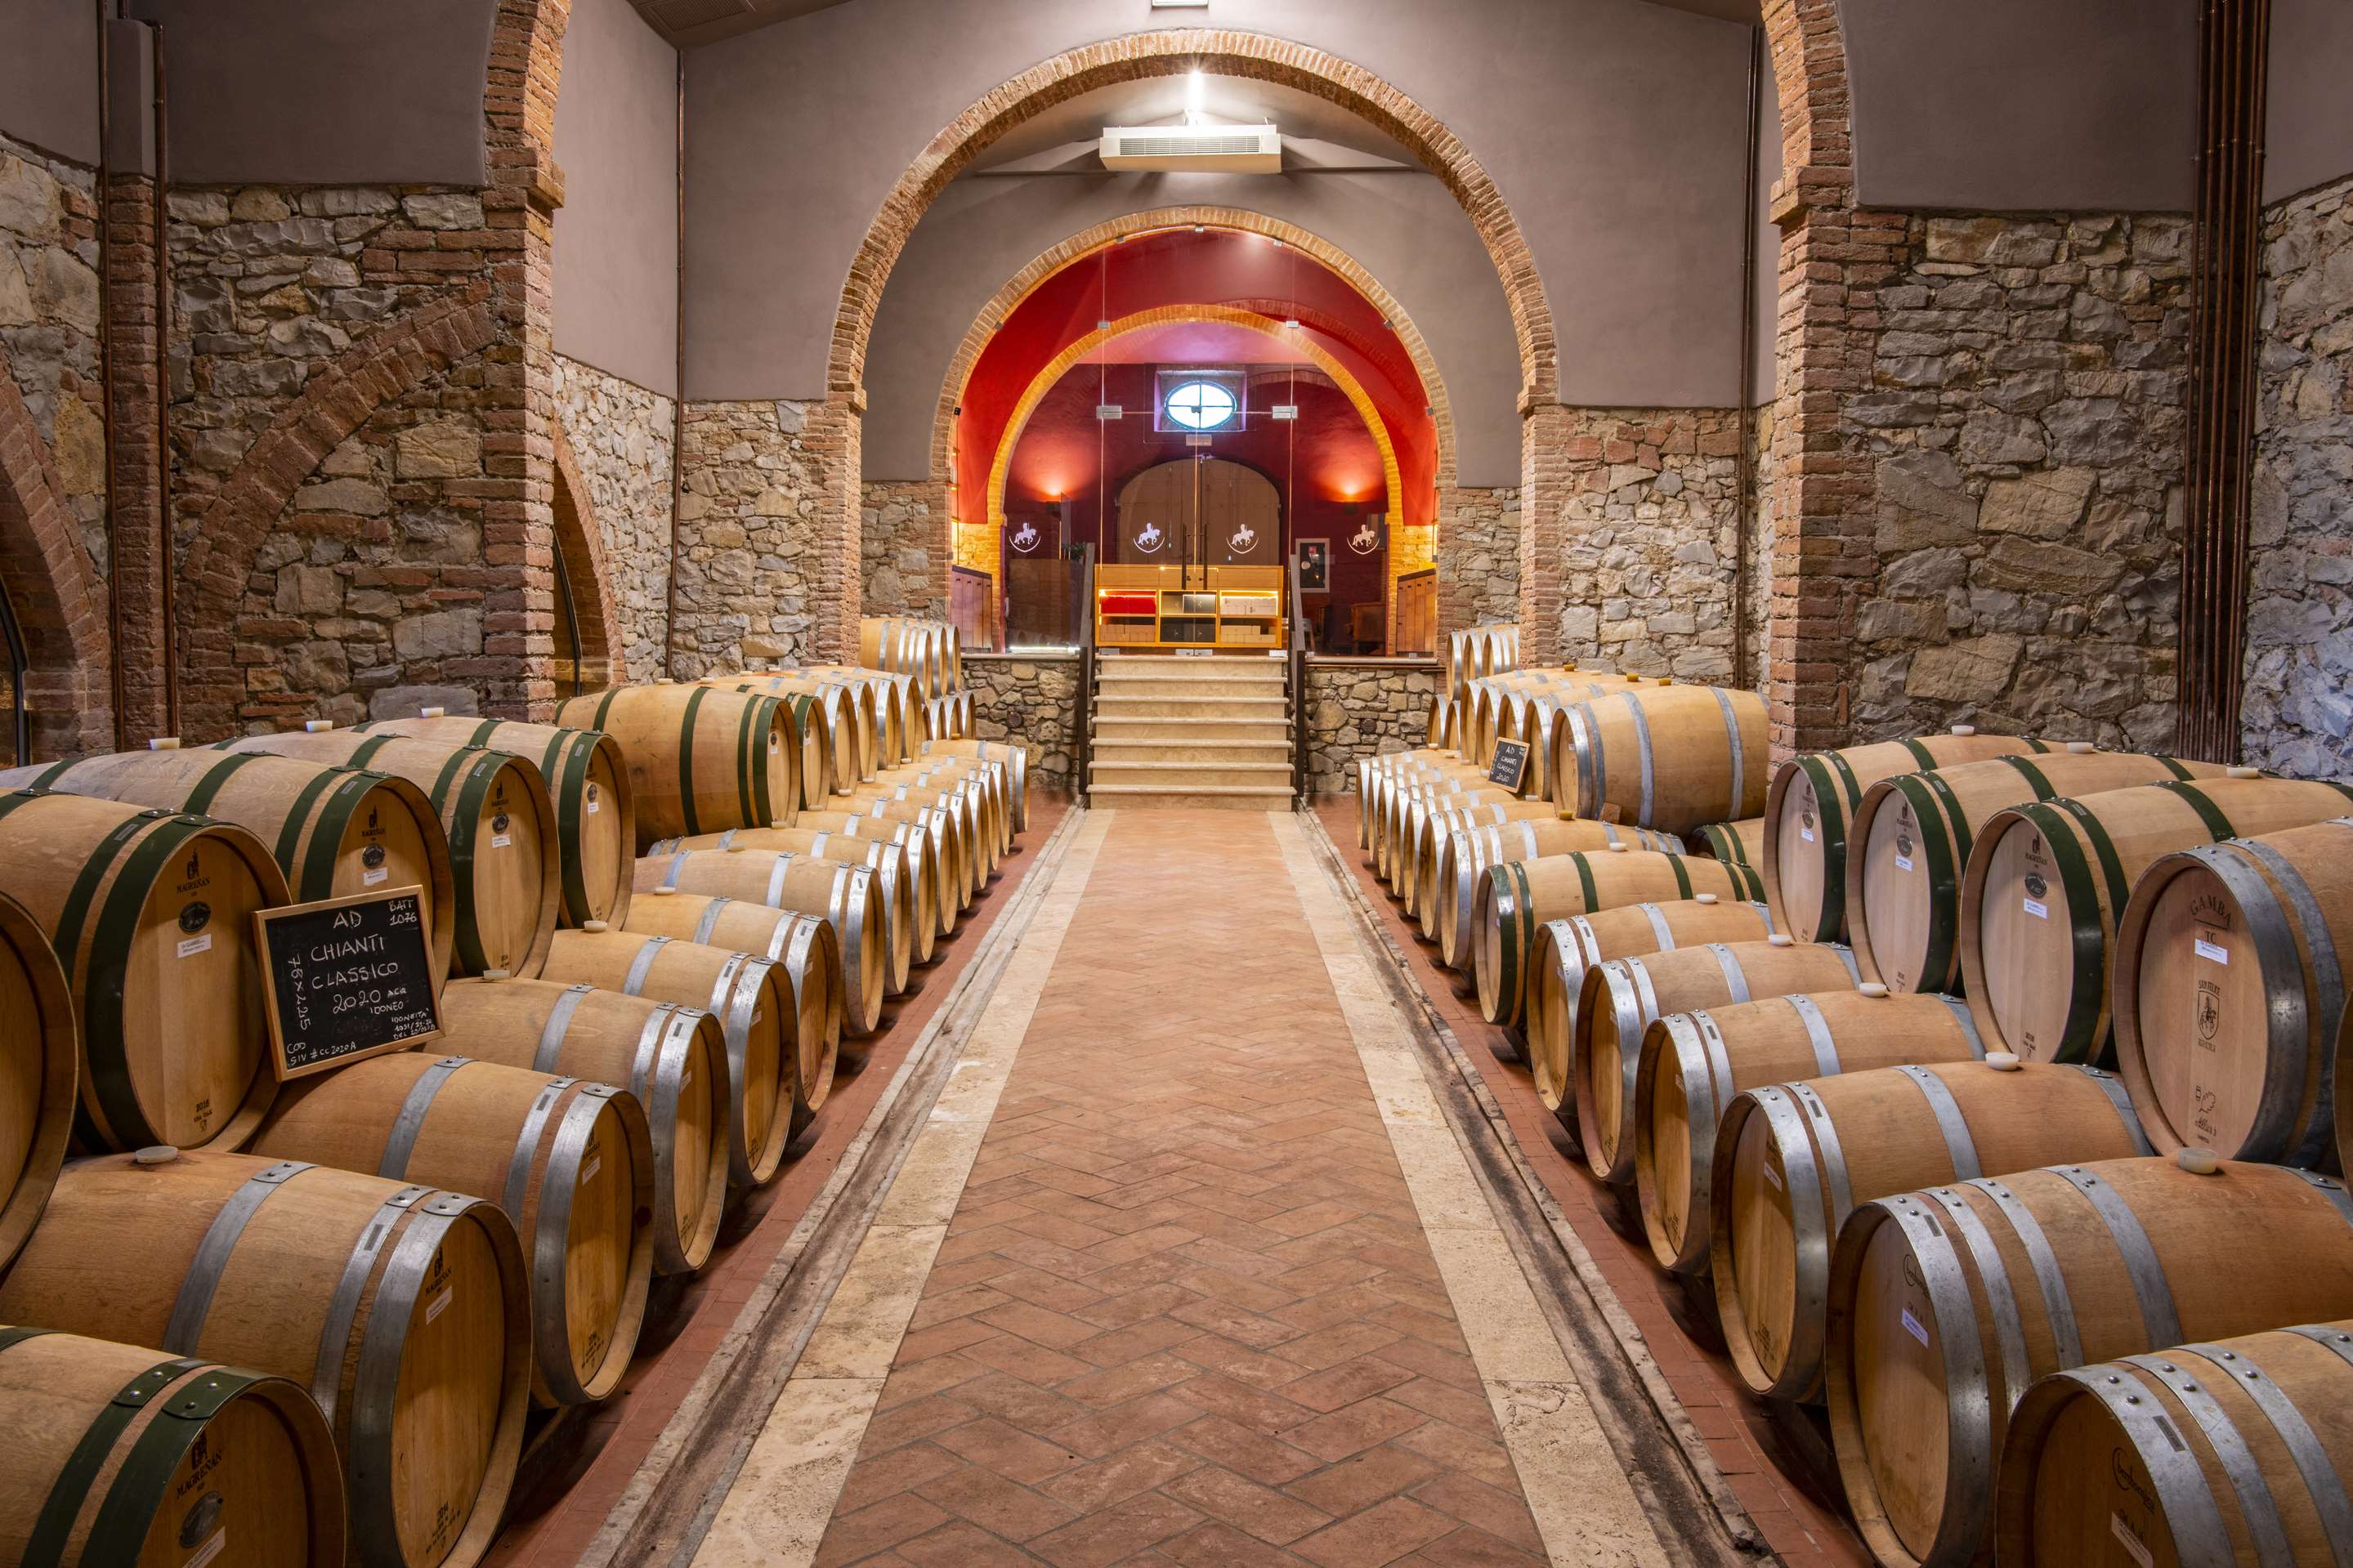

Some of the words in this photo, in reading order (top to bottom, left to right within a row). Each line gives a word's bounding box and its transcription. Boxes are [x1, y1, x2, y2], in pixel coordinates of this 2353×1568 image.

[1505, 745, 1515, 754] AD
[333, 911, 362, 928] AD
[2190, 895, 2230, 928] GAMBA
[311, 933, 384, 962] CHIANTI
[2205, 931, 2217, 944] TC
[311, 963, 398, 989] CLASSICO
[333, 989, 381, 1014] 2020
[370, 1001, 403, 1014] IDONEO
